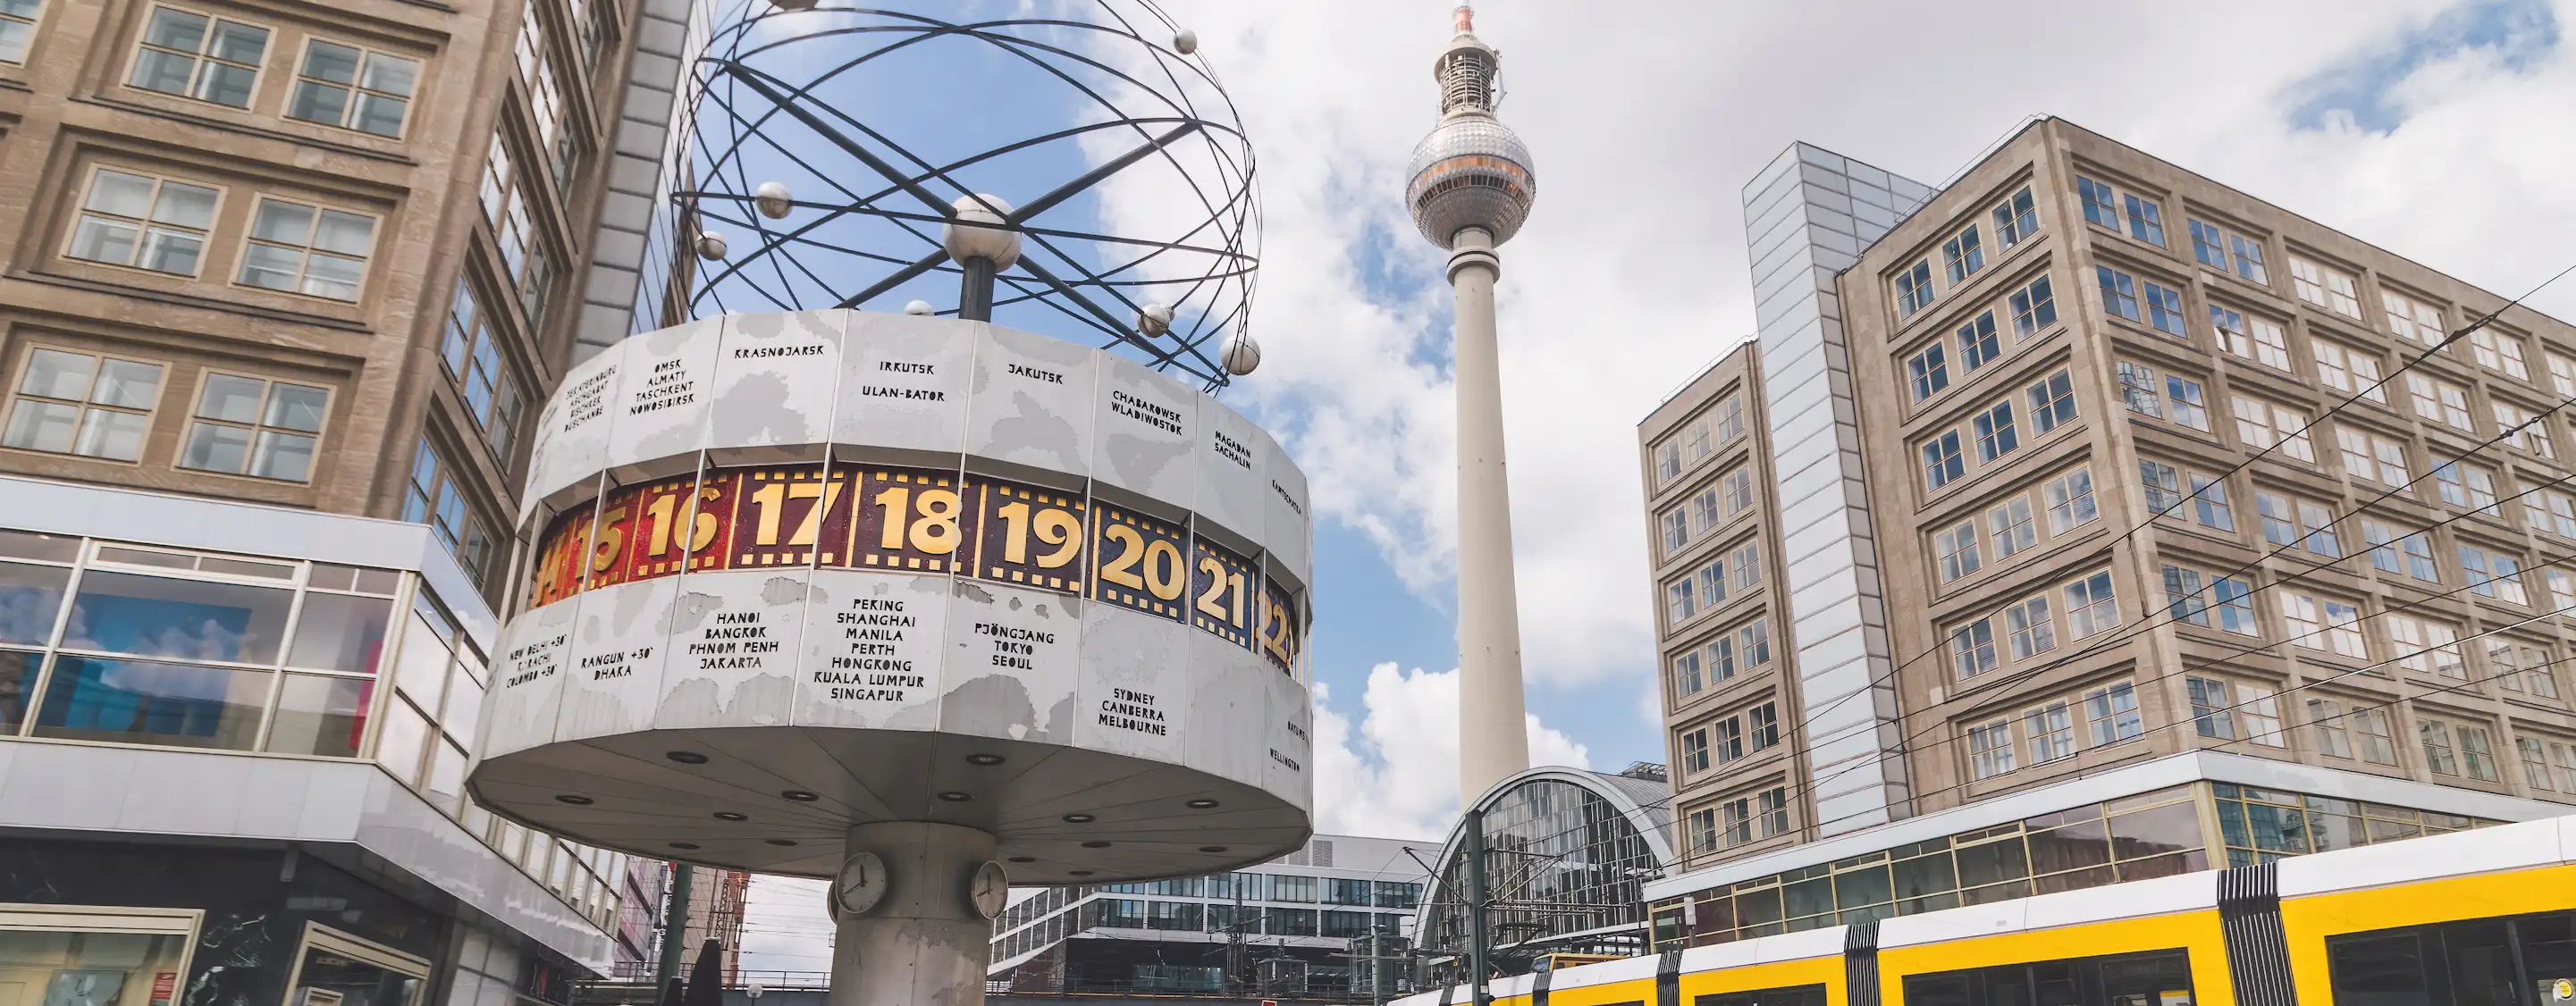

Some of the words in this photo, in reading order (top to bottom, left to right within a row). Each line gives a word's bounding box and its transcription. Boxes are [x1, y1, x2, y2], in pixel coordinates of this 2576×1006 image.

[735, 345, 824, 359] KRASNOJARSK
[654, 359, 682, 373] OMSK
[880, 361, 935, 375] IRKUTSK
[1008, 364, 1064, 384] JAKUTSK
[647, 370, 686, 388] ALMATY
[636, 381, 694, 402] TASCHKENT
[863, 386, 945, 402] ULAN-BATOR
[629, 393, 695, 416] NOWOSIBIRSK
[1113, 390, 1182, 423] CHABAROWSK
[1111, 402, 1183, 436] WLADIWOSTOK
[1215, 431, 1251, 458] MAGADAN
[1215, 443, 1251, 471] SACHALIN
[647, 488, 720, 557] 16
[752, 482, 844, 545] 17
[875, 487, 963, 555] 18
[576, 507, 626, 579] 15
[998, 501, 1082, 568] 19
[1100, 524, 1185, 600] 20
[1197, 557, 1245, 629] 21
[854, 599, 904, 612] PEKING
[717, 613, 760, 625] HANOI
[837, 613, 915, 627] SHANGHAI
[1256, 588, 1288, 663] 22
[705, 627, 766, 640] BANGKOK
[846, 627, 903, 641] MANILA
[974, 623, 1055, 644] PJÖNGJANG
[509, 648, 525, 662] NEW
[527, 641, 548, 656] DELHI
[689, 642, 736, 655] PHNOM
[744, 641, 779, 653] PENH
[851, 642, 895, 656] PERTH
[995, 641, 1033, 656] TOKYO
[581, 651, 625, 669] RANGUN
[700, 658, 762, 669] JAKARTA
[831, 657, 912, 672] HONGKONG
[992, 655, 1032, 670] SEOUL
[507, 670, 538, 688] COLOMBO
[594, 666, 631, 681] DHAKA
[814, 671, 861, 685] KUALA
[869, 675, 924, 688] LUMPUR
[830, 687, 904, 702] SINGAPUR
[1114, 688, 1155, 706] SYDNEY
[1102, 700, 1165, 722] CANBERRA
[1099, 714, 1166, 736] MELBOURNE
[1270, 747, 1300, 774] WELLINGTON
